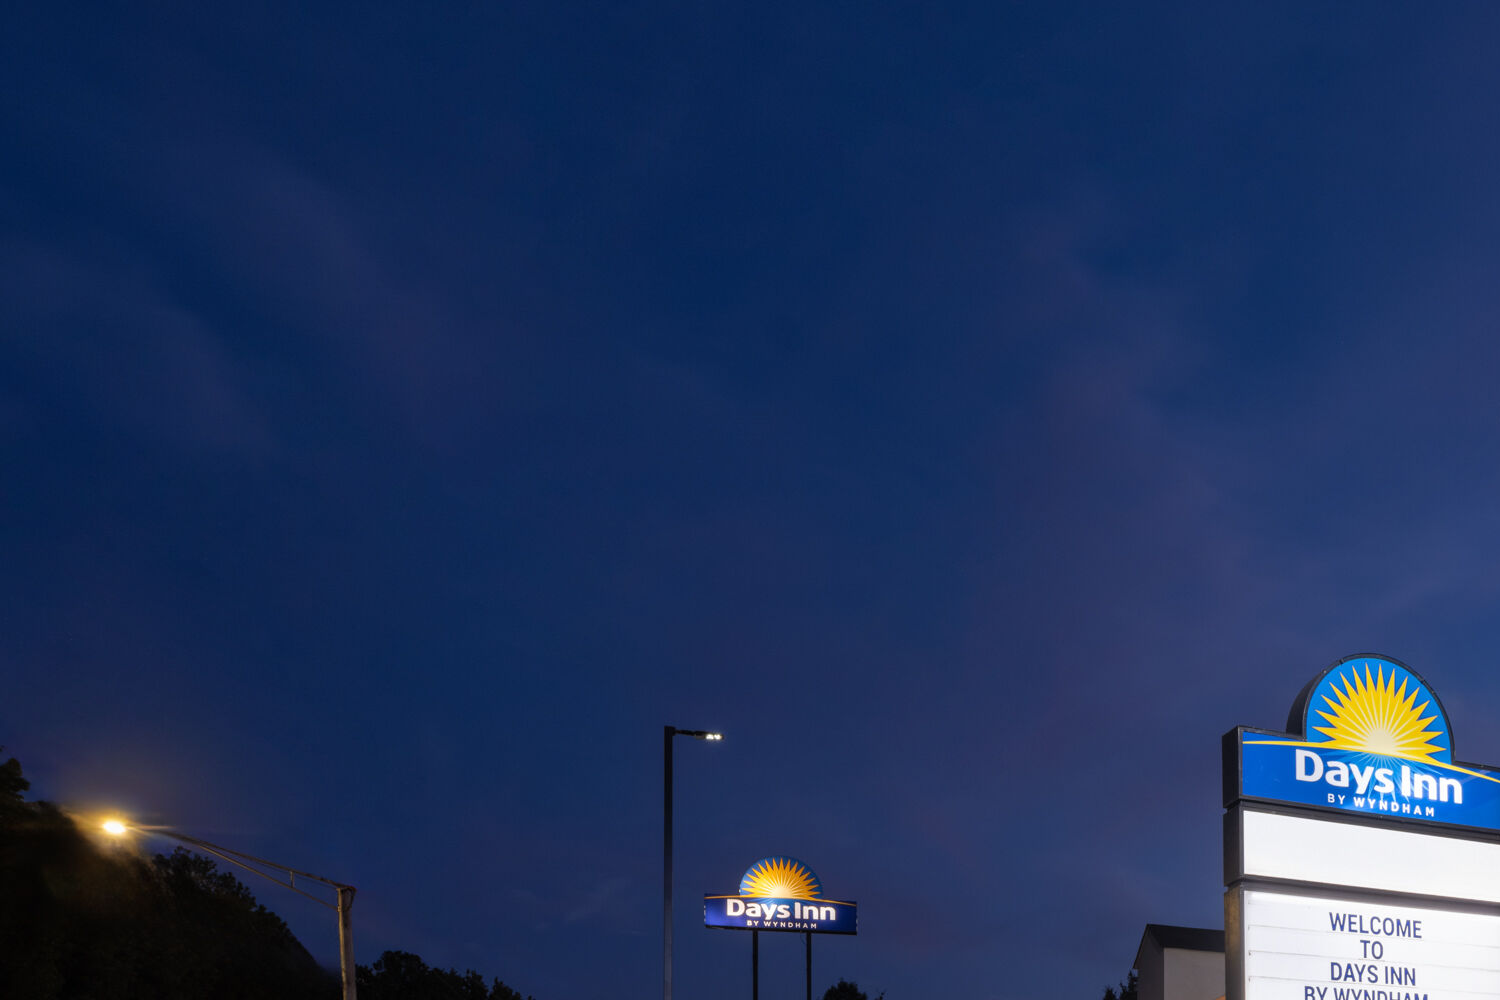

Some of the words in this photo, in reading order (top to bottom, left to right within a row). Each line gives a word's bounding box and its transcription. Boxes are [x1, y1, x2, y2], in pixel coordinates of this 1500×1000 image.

[1295, 749, 1394, 794] Days
[1401, 765, 1463, 804] Inn
[1327, 793, 1346, 805] BY
[1353, 798, 1435, 817] WYNDHAM
[726, 899, 790, 920] Days
[795, 902, 836, 920] Inn
[764, 921, 817, 929] WYNDHAM
[1329, 912, 1422, 938] WELCOME
[1360, 940, 1383, 959] TO
[1330, 962, 1378, 983] DAYS
[1385, 966, 1416, 986] INN
